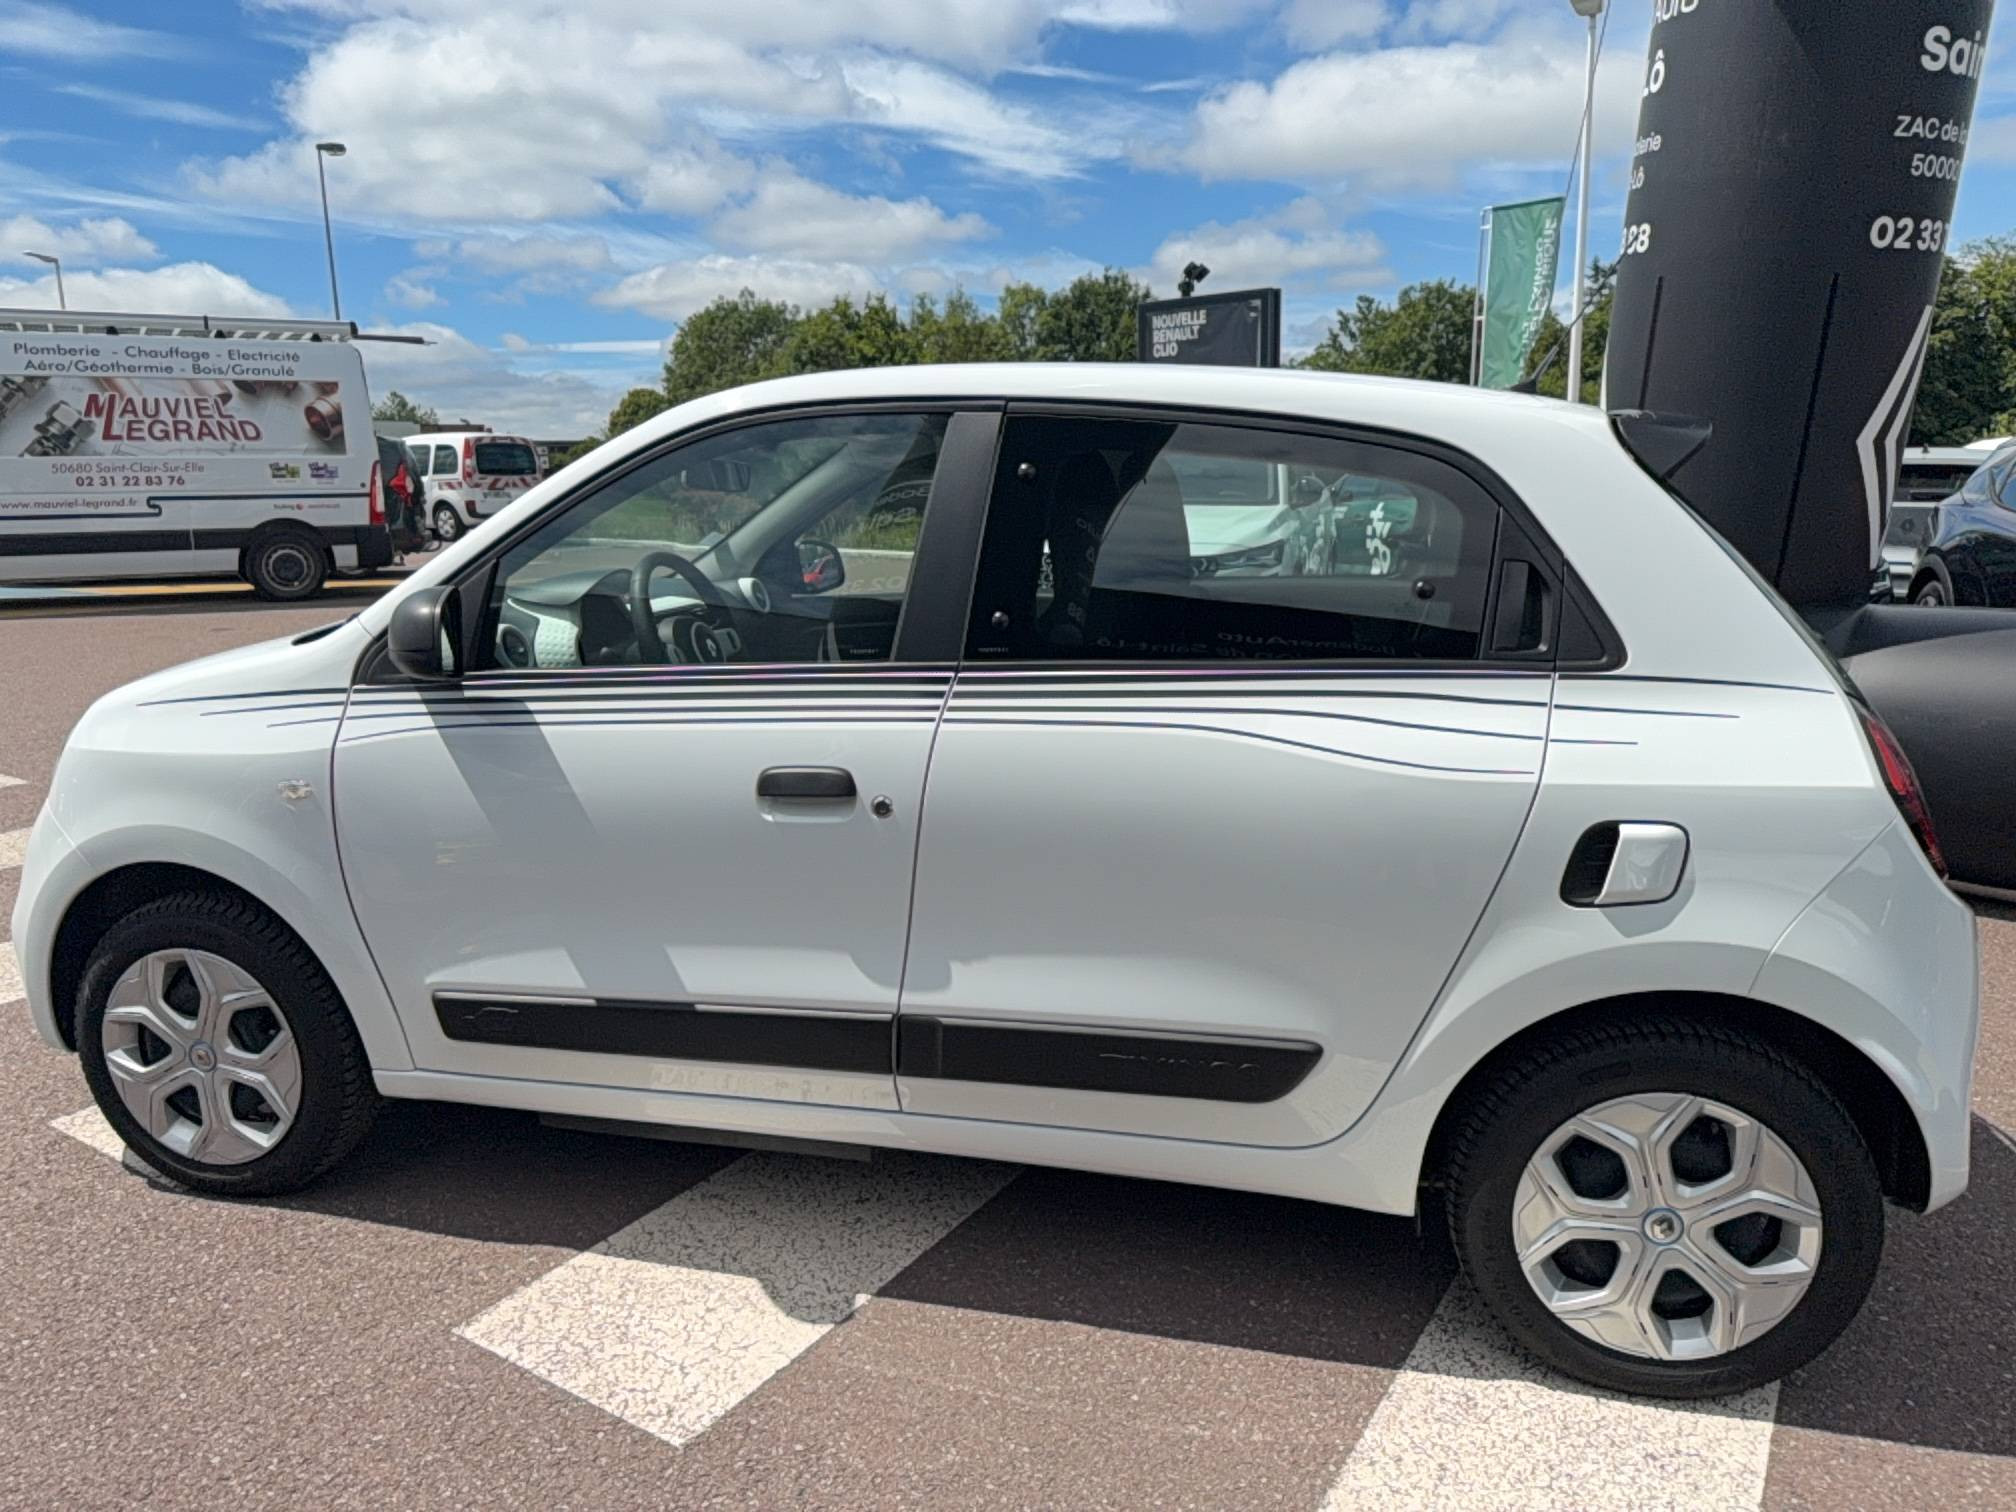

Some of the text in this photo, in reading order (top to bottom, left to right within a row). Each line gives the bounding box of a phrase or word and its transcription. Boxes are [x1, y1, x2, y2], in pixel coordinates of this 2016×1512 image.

[1893, 115, 1940, 139] ZAC
[1941, 119, 1959, 143] de
[1869, 215, 1944, 252] 02 33
[1152, 309, 1208, 330] NOUVELLE
[1153, 325, 1201, 345] RENAULT
[13, 342, 101, 357] Plomberie
[124, 346, 210, 362] Chauffage
[227, 349, 301, 362] Electricité
[1153, 341, 1179, 359] CLIO
[191, 363, 296, 377] Bois/Granulé
[83, 393, 237, 420] MAUVIEL
[102, 393, 264, 442] LEGRAND
[51, 461, 205, 474] 50680 Saint-Clair-Sur-Elle
[76, 476, 185, 487] 02 31 22 83 76
